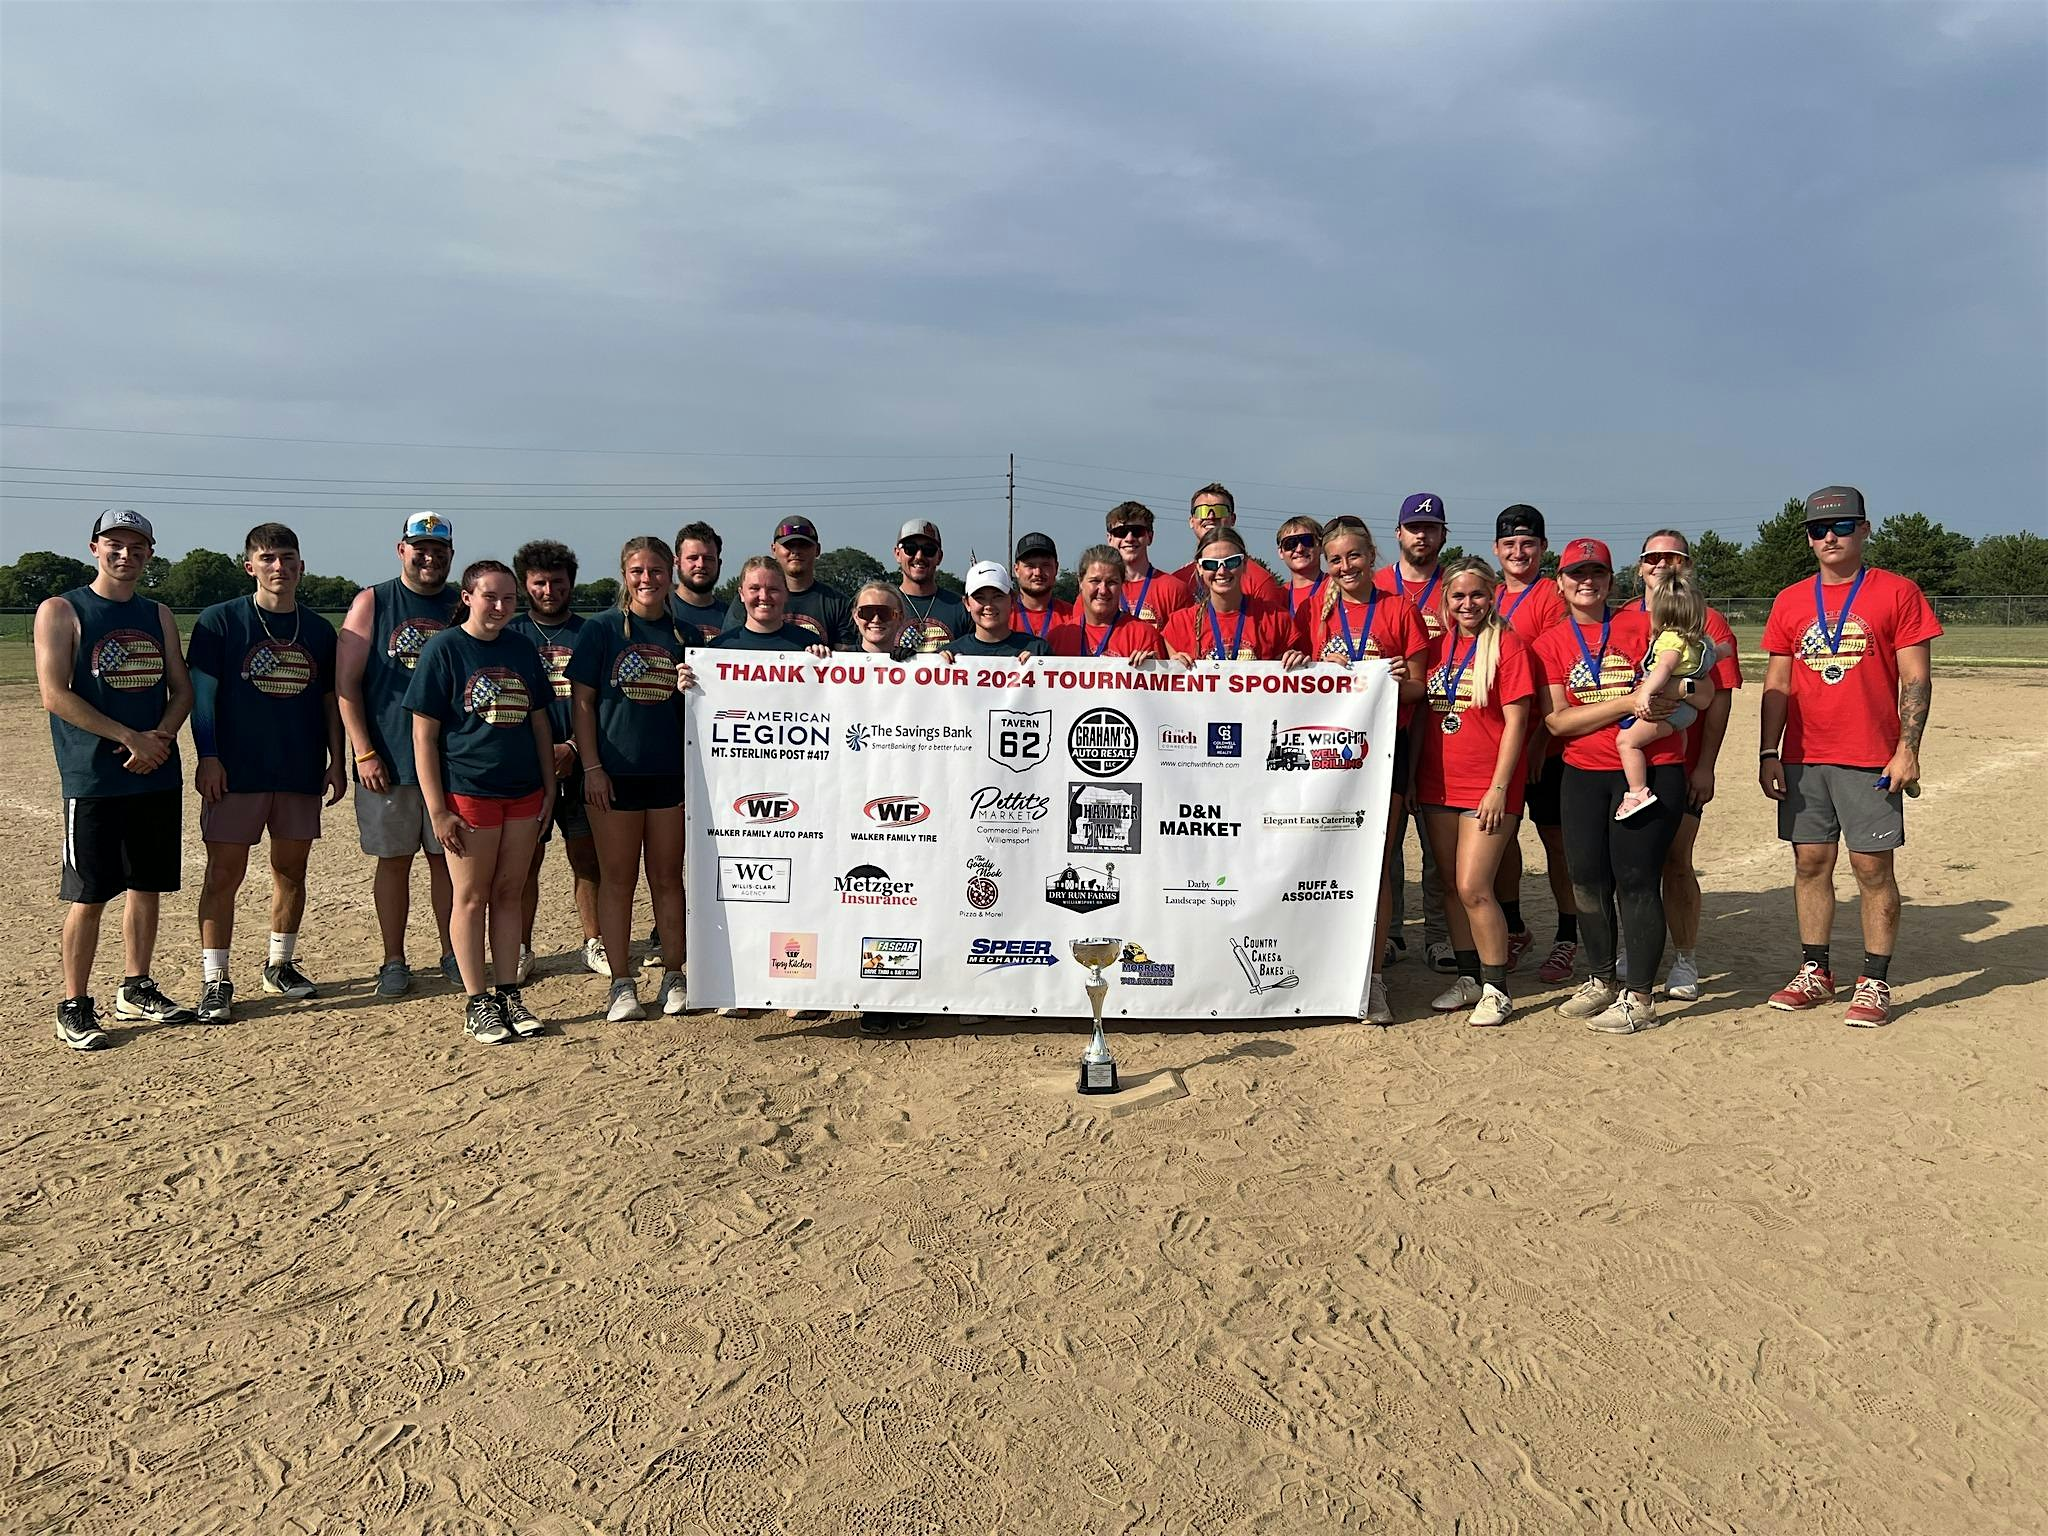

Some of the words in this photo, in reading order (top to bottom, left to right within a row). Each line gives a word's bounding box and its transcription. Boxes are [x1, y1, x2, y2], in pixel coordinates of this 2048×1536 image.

[716, 663, 805, 683] THANK
[812, 665, 865, 684] YOU
[873, 666, 906, 685] TO
[914, 667, 969, 686] OUR
[976, 670, 1036, 689] 2024
[1043, 671, 1221, 693] TOURNAMENT
[1228, 674, 1368, 694] SPONSORS
[746, 711, 831, 723] AMERICAN
[1001, 718, 1040, 728] TAVERN
[712, 723, 830, 746] LEGION
[871, 724, 892, 737] The
[895, 725, 940, 741] Savings
[943, 725, 972, 739] Bank
[1075, 726, 1131, 748] GRAHAM'S
[1162, 730, 1197, 744] finch
[1281, 733, 1305, 746] J.E.
[1308, 731, 1367, 745] WRIGHT
[872, 743, 916, 752] SmartBanking
[918, 743, 927, 752] for
[953, 744, 973, 752] future
[1000, 731, 1040, 759] 62
[711, 747, 728, 758] MT.
[730, 747, 778, 760] STERLING
[779, 750, 805, 760] POST
[807, 750, 830, 761] #417
[1071, 749, 1099, 758] AUTO
[1100, 750, 1136, 758] RESALE
[1310, 748, 1341, 758] WELL
[1311, 759, 1364, 769] DRILLING
[747, 799, 789, 818] WF
[877, 803, 920, 822] WF
[1083, 804, 1139, 820] HAMMER
[1179, 804, 1221, 819] D&N
[978, 810, 1032, 821] MARKET
[1263, 816, 1298, 826] Elegant
[1300, 816, 1320, 825] Eats
[1321, 815, 1355, 825] Catering
[706, 828, 740, 837] WALKER
[742, 830, 772, 838] FAMILY
[773, 830, 796, 839] AUTO
[798, 831, 824, 840] PARTS
[976, 826, 1020, 834] Commercial
[1160, 821, 1242, 837] MARKET
[850, 833, 885, 841] WALKER
[886, 834, 917, 842] FAMILY
[986, 836, 1030, 846] Williamsport
[966, 858, 995, 870] Goody
[734, 863, 774, 881] WC
[833, 876, 914, 896] Metzger
[1187, 880, 1211, 890] Darby
[1298, 880, 1328, 890] RUFF
[1329, 879, 1339, 889] &
[840, 892, 918, 906] Insurance
[1048, 891, 1067, 899] DRY
[1067, 891, 1087, 900] RUN
[1087, 892, 1117, 900] FARMS
[1165, 896, 1206, 906] Landscape
[1210, 897, 1237, 907] Supply
[1281, 890, 1354, 902] ASSOCIATES
[959, 910, 977, 918] Pizza
[877, 941, 915, 952] FASCAR
[970, 938, 1052, 955] SPEER
[1243, 935, 1278, 948] COUNTRY
[968, 955, 1049, 964] MECHANICAL
[1251, 950, 1277, 963] CAKES
[771, 958, 788, 970] Tipsy
[1121, 962, 1175, 972] MORRISON
[1259, 963, 1284, 976] BAKES
